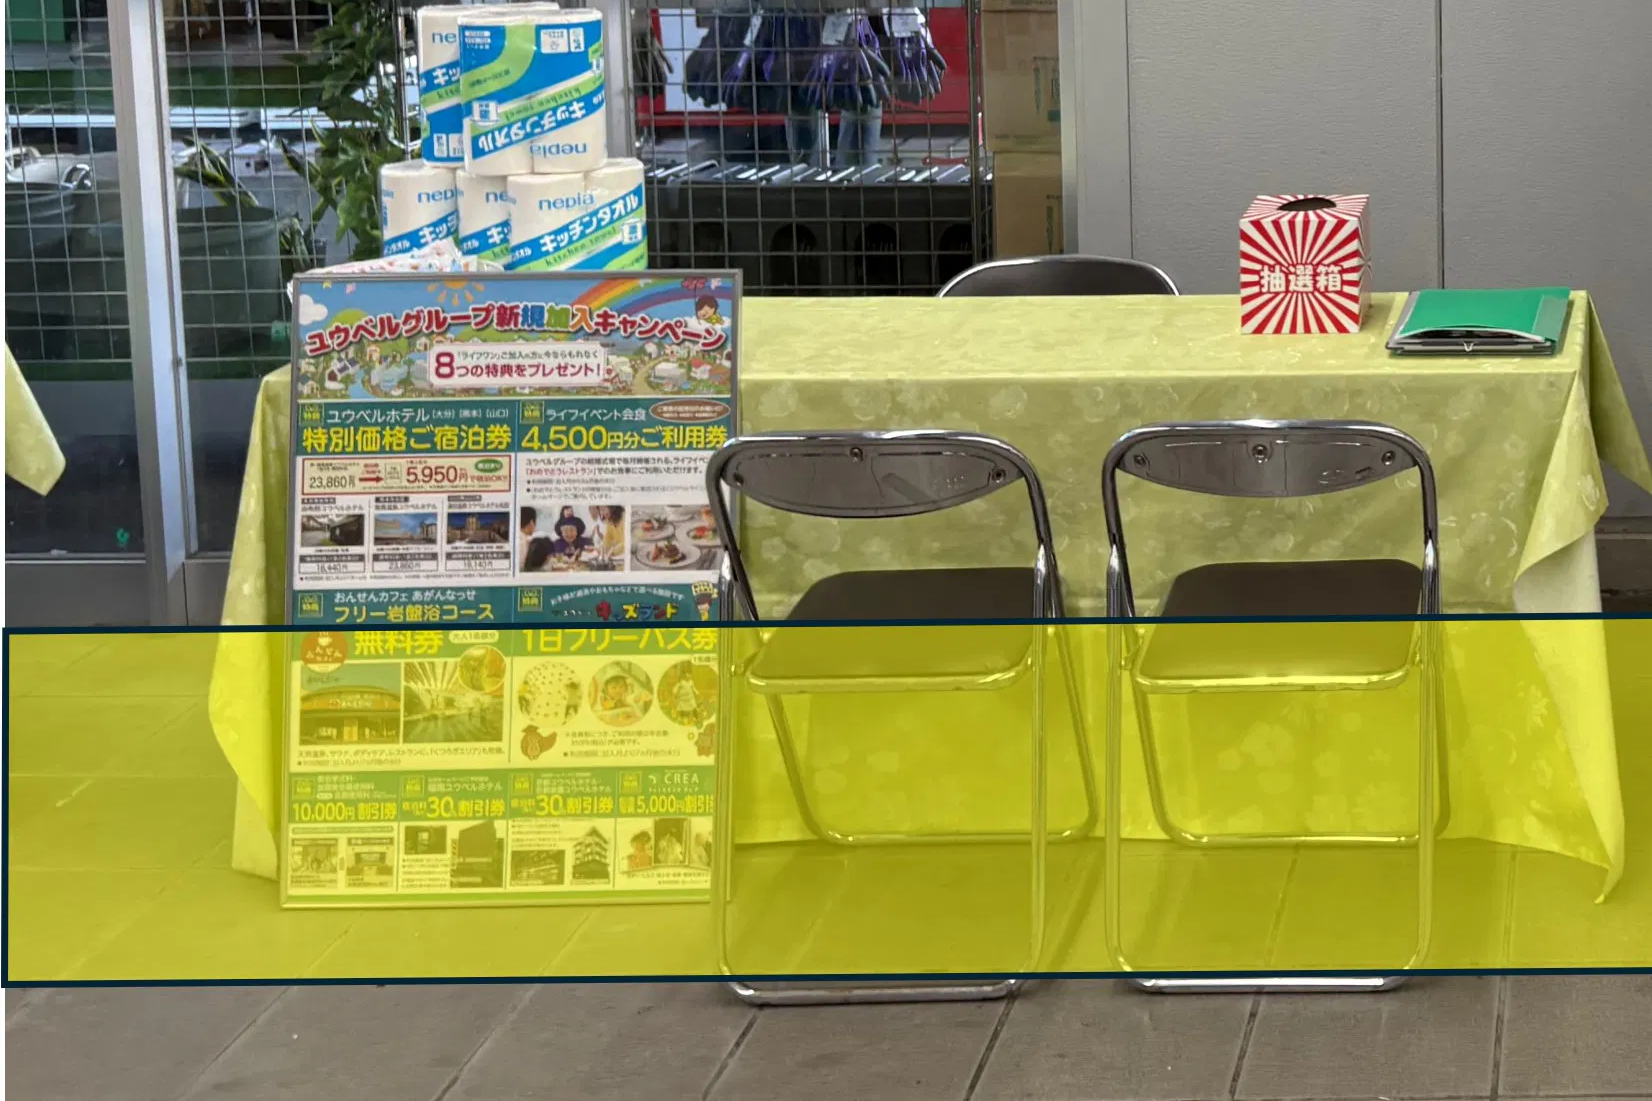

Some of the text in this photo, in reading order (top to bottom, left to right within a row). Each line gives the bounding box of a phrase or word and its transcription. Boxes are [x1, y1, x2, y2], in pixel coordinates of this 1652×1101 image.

[529, 141, 587, 158] nepia
[538, 190, 595, 211] nepia
[539, 193, 639, 253] キッチンタオル
[1259, 264, 1343, 293] 抽選箱
[305, 299, 728, 357] ユウベルグループ新規加入キャンペーン
[434, 351, 601, 379] 8つの特典をプレゼント！
[327, 407, 430, 424] ユウベルホテル
[546, 407, 647, 422] ライフイベント会食
[302, 424, 512, 454] 特別価格ご宿泊券
[521, 424, 728, 452] 4,500円分ご利用券
[334, 604, 495, 623] フリー岩盤浴コース
